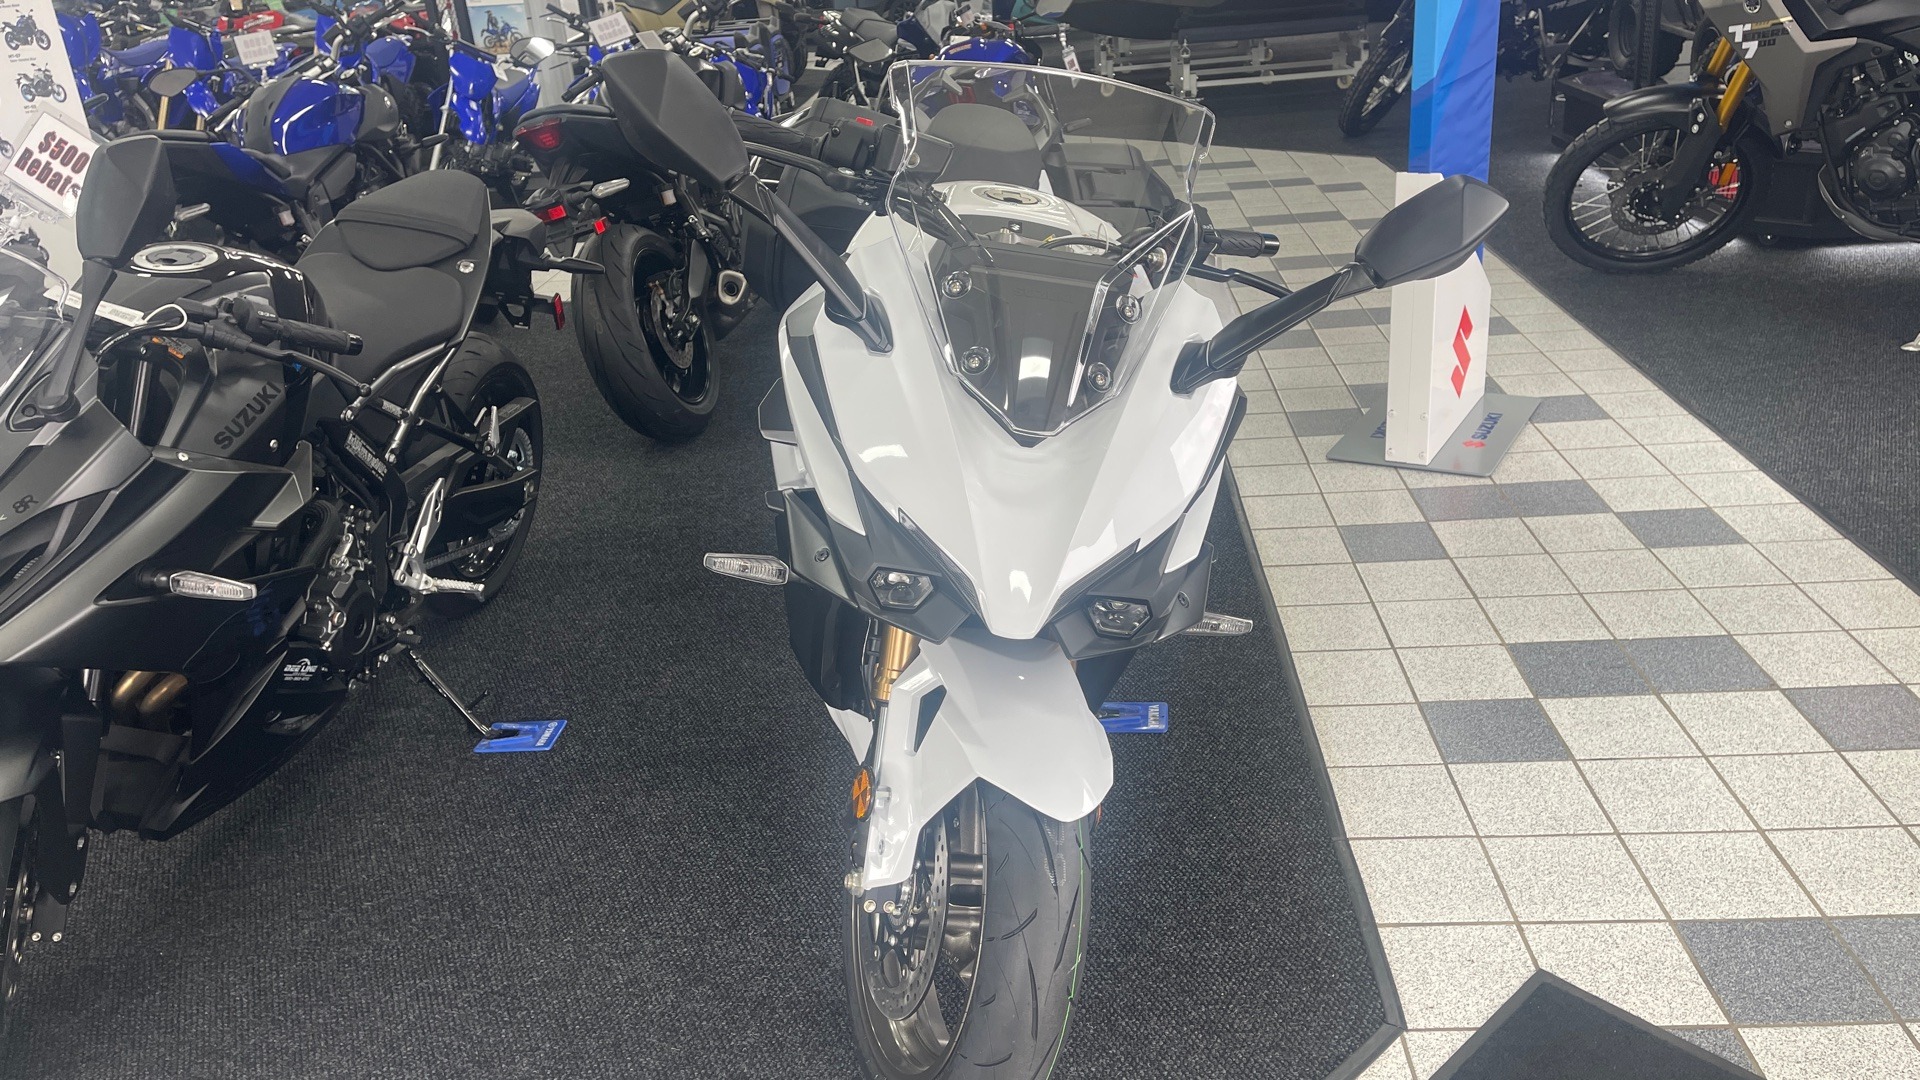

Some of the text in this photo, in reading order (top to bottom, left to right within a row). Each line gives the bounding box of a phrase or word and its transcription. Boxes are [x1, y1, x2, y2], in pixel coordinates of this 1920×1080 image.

[38, 130, 91, 175] $500
[213, 380, 282, 450] SUZUKI
[1471, 411, 1504, 441] SUZUKI
[12, 493, 40, 514] 8R
